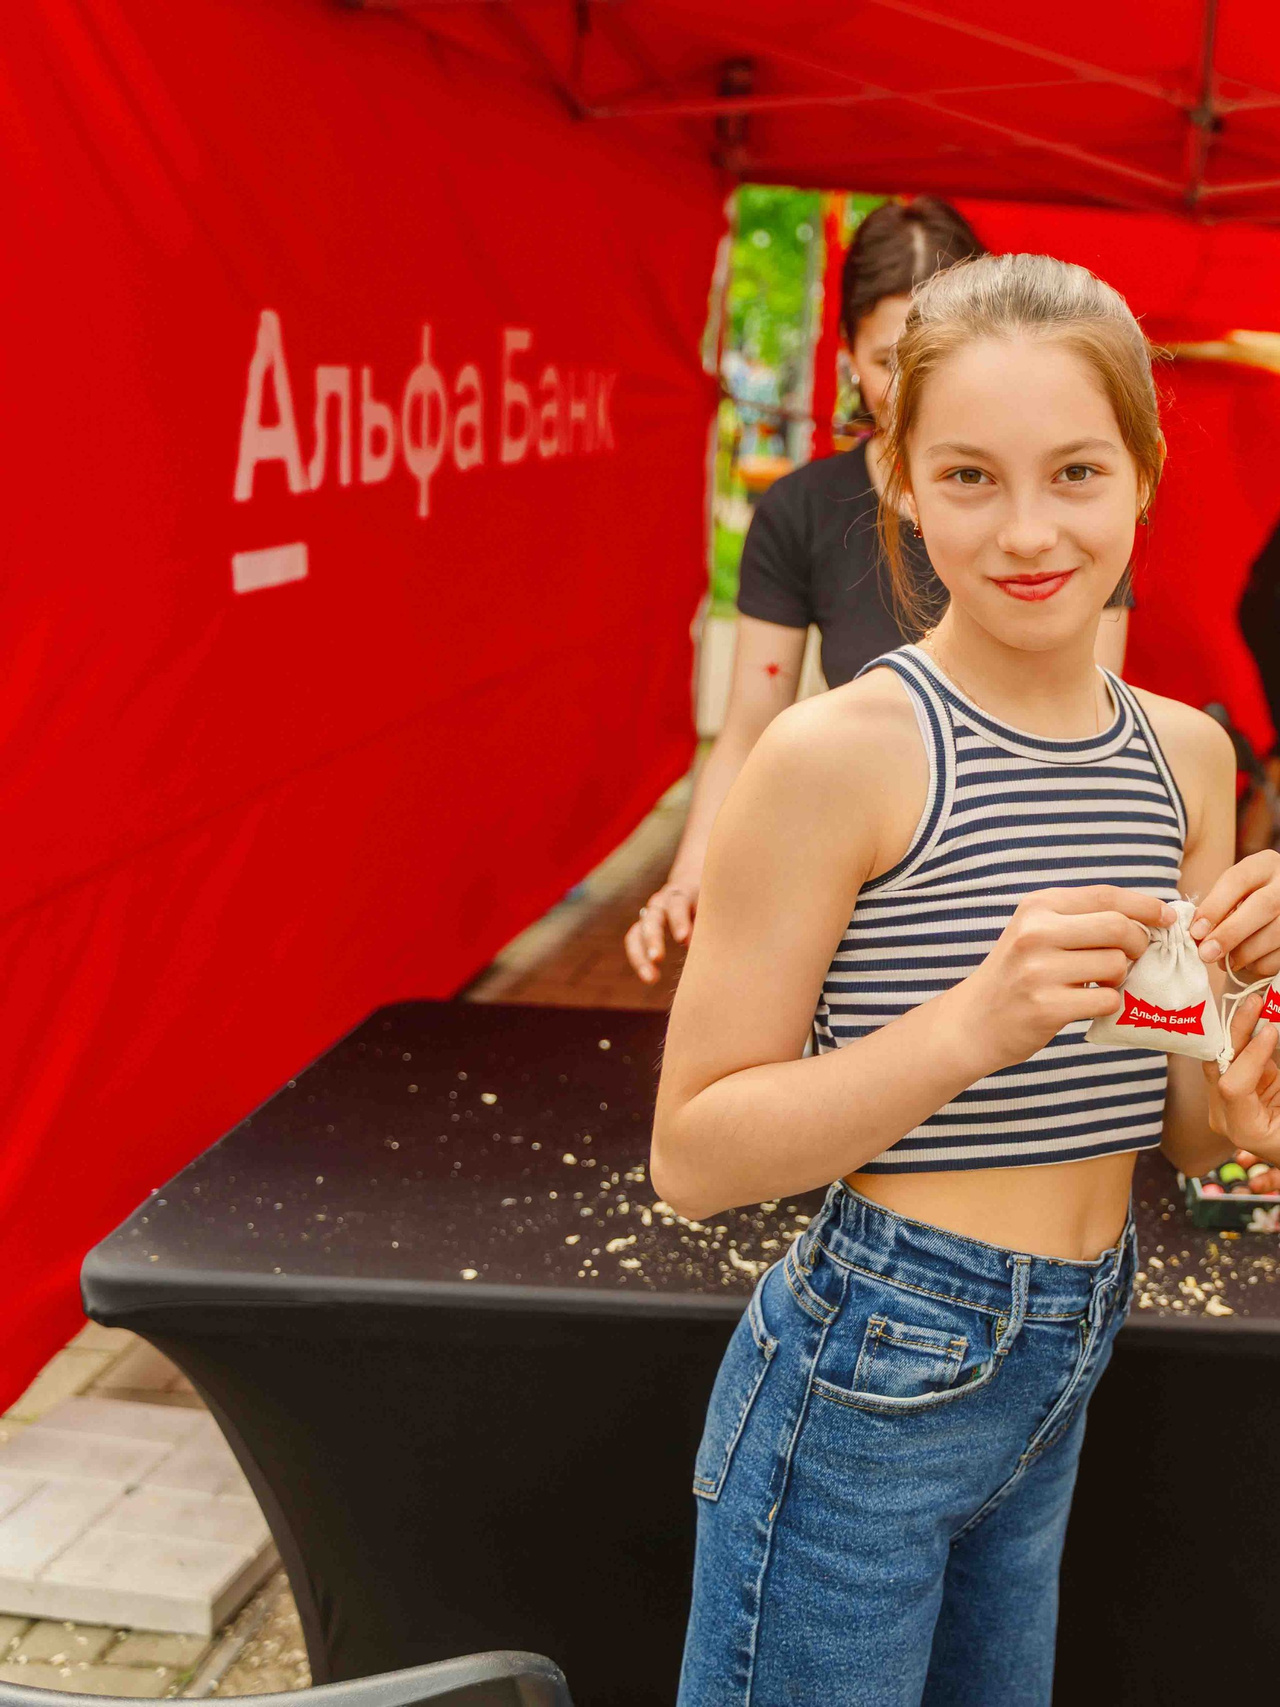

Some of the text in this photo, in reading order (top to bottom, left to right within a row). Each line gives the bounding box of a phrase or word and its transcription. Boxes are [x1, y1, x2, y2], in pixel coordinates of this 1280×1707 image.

[233, 309, 616, 517] Альфа Банк
[1129, 1006, 1197, 1024] Альфа Банк
